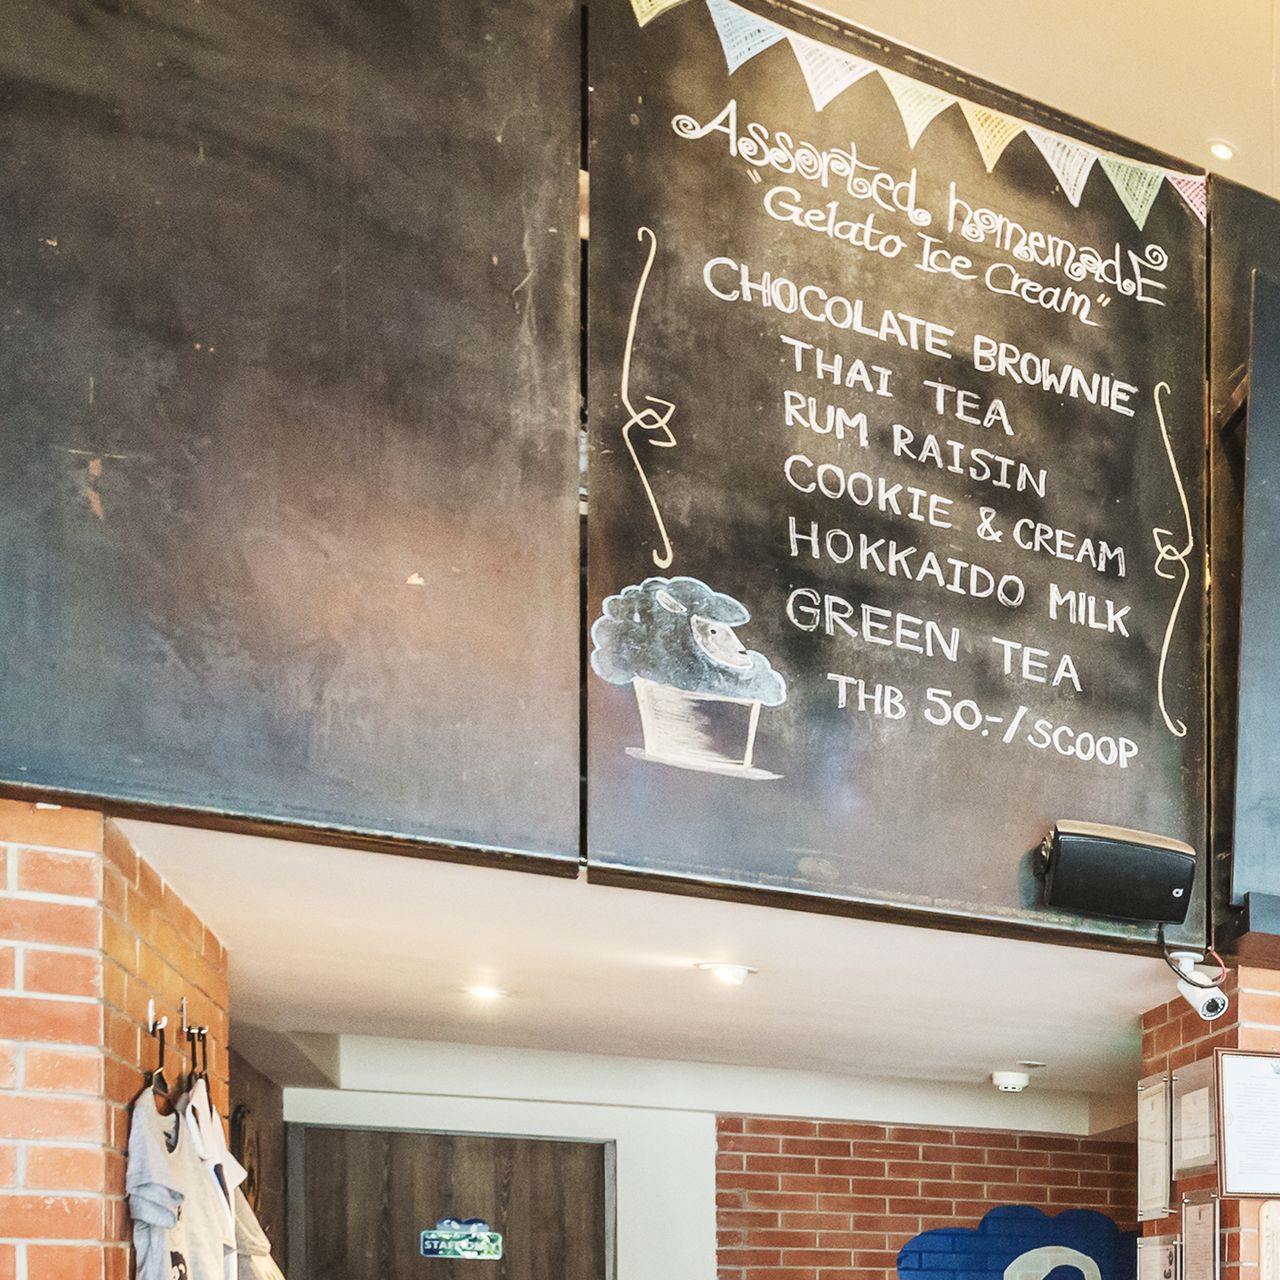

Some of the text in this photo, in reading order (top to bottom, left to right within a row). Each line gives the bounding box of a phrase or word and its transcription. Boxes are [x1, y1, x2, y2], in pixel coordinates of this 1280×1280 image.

[672, 100, 931, 228] Assorted
[915, 232, 977, 281] Ice
[703, 257, 1139, 417] CHOCOLATE BROWNIE
[780, 335, 1014, 437] THAI TEA
[784, 390, 1047, 499] RUM RAISIN
[784, 455, 1126, 578] COOKIE & CREAM
[788, 516, 1132, 638] HOKKAIDO MILK
[786, 588, 1082, 692] GREEN TEA
[827, 673, 906, 720] THB
